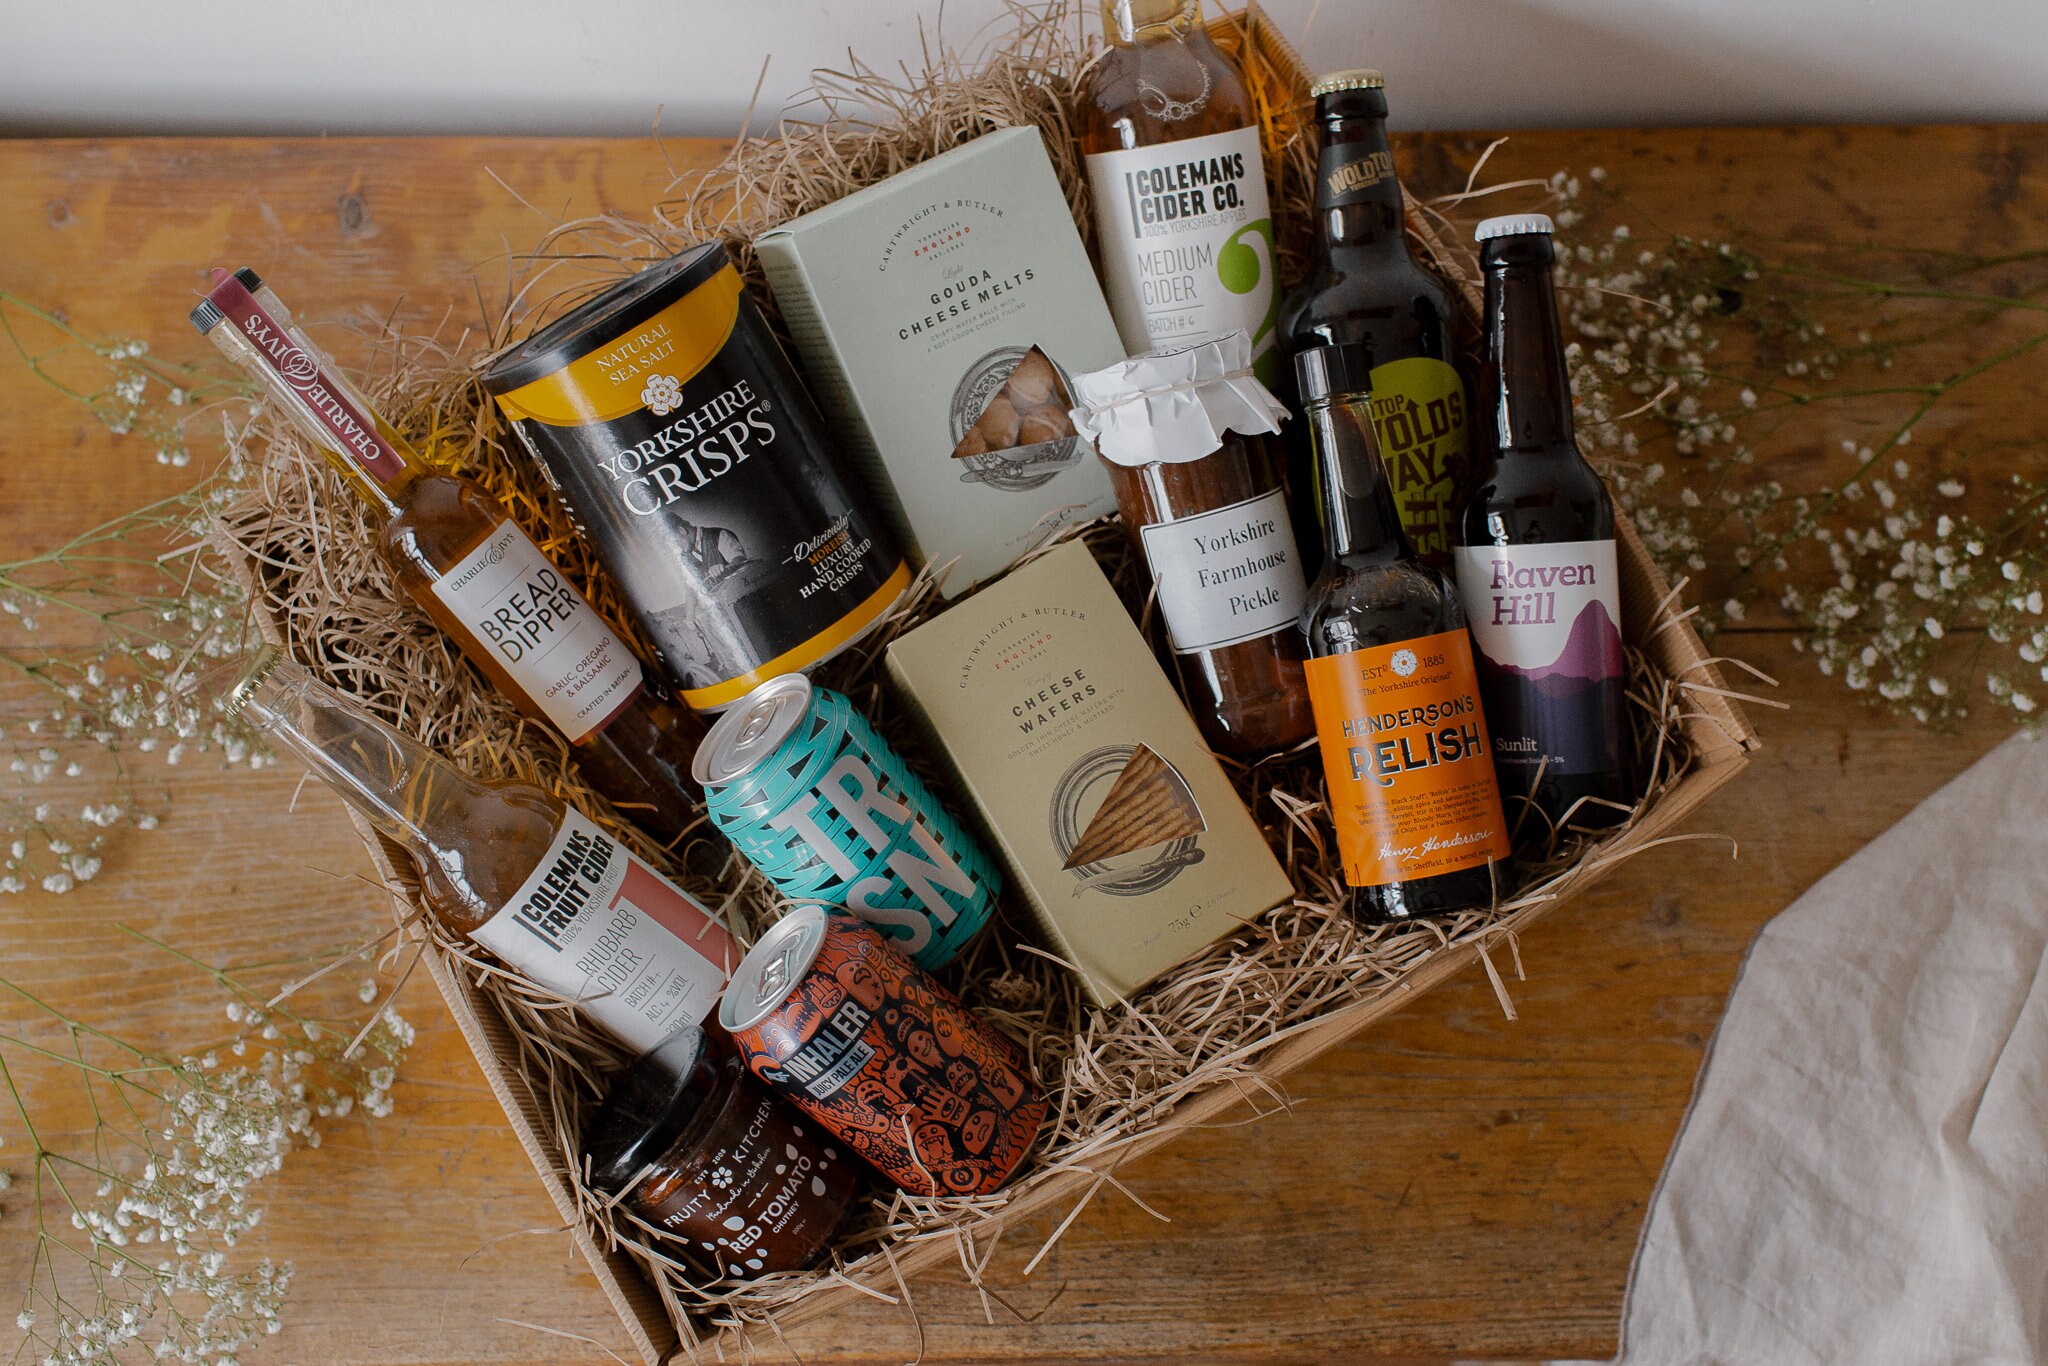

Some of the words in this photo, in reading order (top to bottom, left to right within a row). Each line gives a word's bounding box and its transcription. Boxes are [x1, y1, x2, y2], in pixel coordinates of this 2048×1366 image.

[1136, 152, 1245, 197] COLEMANS
[1140, 190, 1207, 224] CIDER
[1213, 182, 1245, 211] CO.
[1143, 224, 1169, 238] 100%
[1169, 214, 1219, 235] YORKSHIRE
[1220, 208, 1248, 226] APPLES
[879, 204, 938, 272] CARTWRIGHT
[943, 201, 951, 209] &
[957, 199, 1004, 219] BUTLER
[913, 226, 971, 257] ENGLAND
[1138, 243, 1213, 277] MEDIUM
[898, 299, 972, 341] CHEESE
[978, 268, 1035, 304] MELTS
[930, 269, 993, 306] GOUDA
[1142, 275, 1197, 306] CIDER
[244, 314, 286, 360] IVY'S
[1148, 316, 1177, 334] BATCH
[596, 323, 672, 372] NATURAL
[609, 365, 641, 386] SEA
[640, 339, 677, 369] SALT
[308, 384, 381, 462] CHARLIE
[597, 379, 756, 481] YORKSHIRE
[793, 515, 850, 563] Deliciously
[807, 529, 851, 566] MOREISH
[813, 539, 856, 576] LUXURY
[1194, 519, 1276, 555] Yorkshire
[450, 560, 488, 592] CHARLIE
[799, 569, 835, 599] HAND
[835, 538, 872, 573] COOKED
[829, 561, 864, 592] CRISPS
[1197, 549, 1287, 588] Farmhouse
[1490, 559, 1596, 591] Raven
[479, 568, 559, 643] BREAD
[1228, 586, 1280, 617] Pickle
[1491, 591, 1556, 626] Hill
[498, 587, 580, 664] DIPPER
[545, 671, 578, 698] GARLIC,
[575, 636, 611, 674] OREGANO
[959, 615, 1014, 689] CARTWRIGHT
[1035, 607, 1087, 621] BUTLER
[994, 633, 1052, 670] ENGLAND
[1422, 654, 1445, 669] 1885
[566, 689, 575, 698] &
[573, 655, 612, 692] BALSAMIC
[577, 695, 605, 719] CRAFTED
[603, 687, 612, 698] IN
[610, 667, 632, 690] BRITAIN
[1012, 668, 1086, 717] CHEESE
[1379, 679, 1420, 694] Yorkshire
[1019, 684, 1096, 735] WAFERS
[1342, 695, 1475, 739] HENDERSON'S
[1347, 722, 1484, 788] RELISH
[1496, 736, 1538, 752] Sunlit
[1421, 829, 1494, 857] Henderson
[520, 829, 592, 923] COLEMANS
[538, 880, 591, 939] FRUIT
[580, 834, 615, 885] CIDER
[559, 924, 583, 946] 100%
[576, 884, 611, 927] YORKSHIRE
[607, 863, 621, 887] FRUIT
[575, 909, 638, 977] RHUBARB
[597, 948, 643, 994] CIDER
[624, 981, 652, 1008] BATCH
[645, 1004, 663, 1023] ALC
[782, 1001, 871, 1084] INHALER
[812, 1076, 837, 1096] JUICY
[832, 1060, 856, 1083] PALE
[849, 1045, 870, 1067] ALE
[663, 1188, 712, 1228] FRUITY
[731, 1096, 773, 1164] KITCHEN
[711, 1148, 727, 1165] 2008
[728, 1225, 763, 1254] RED
[757, 1155, 812, 1226] TOMATO
[772, 1200, 801, 1234] CHUTNEY
